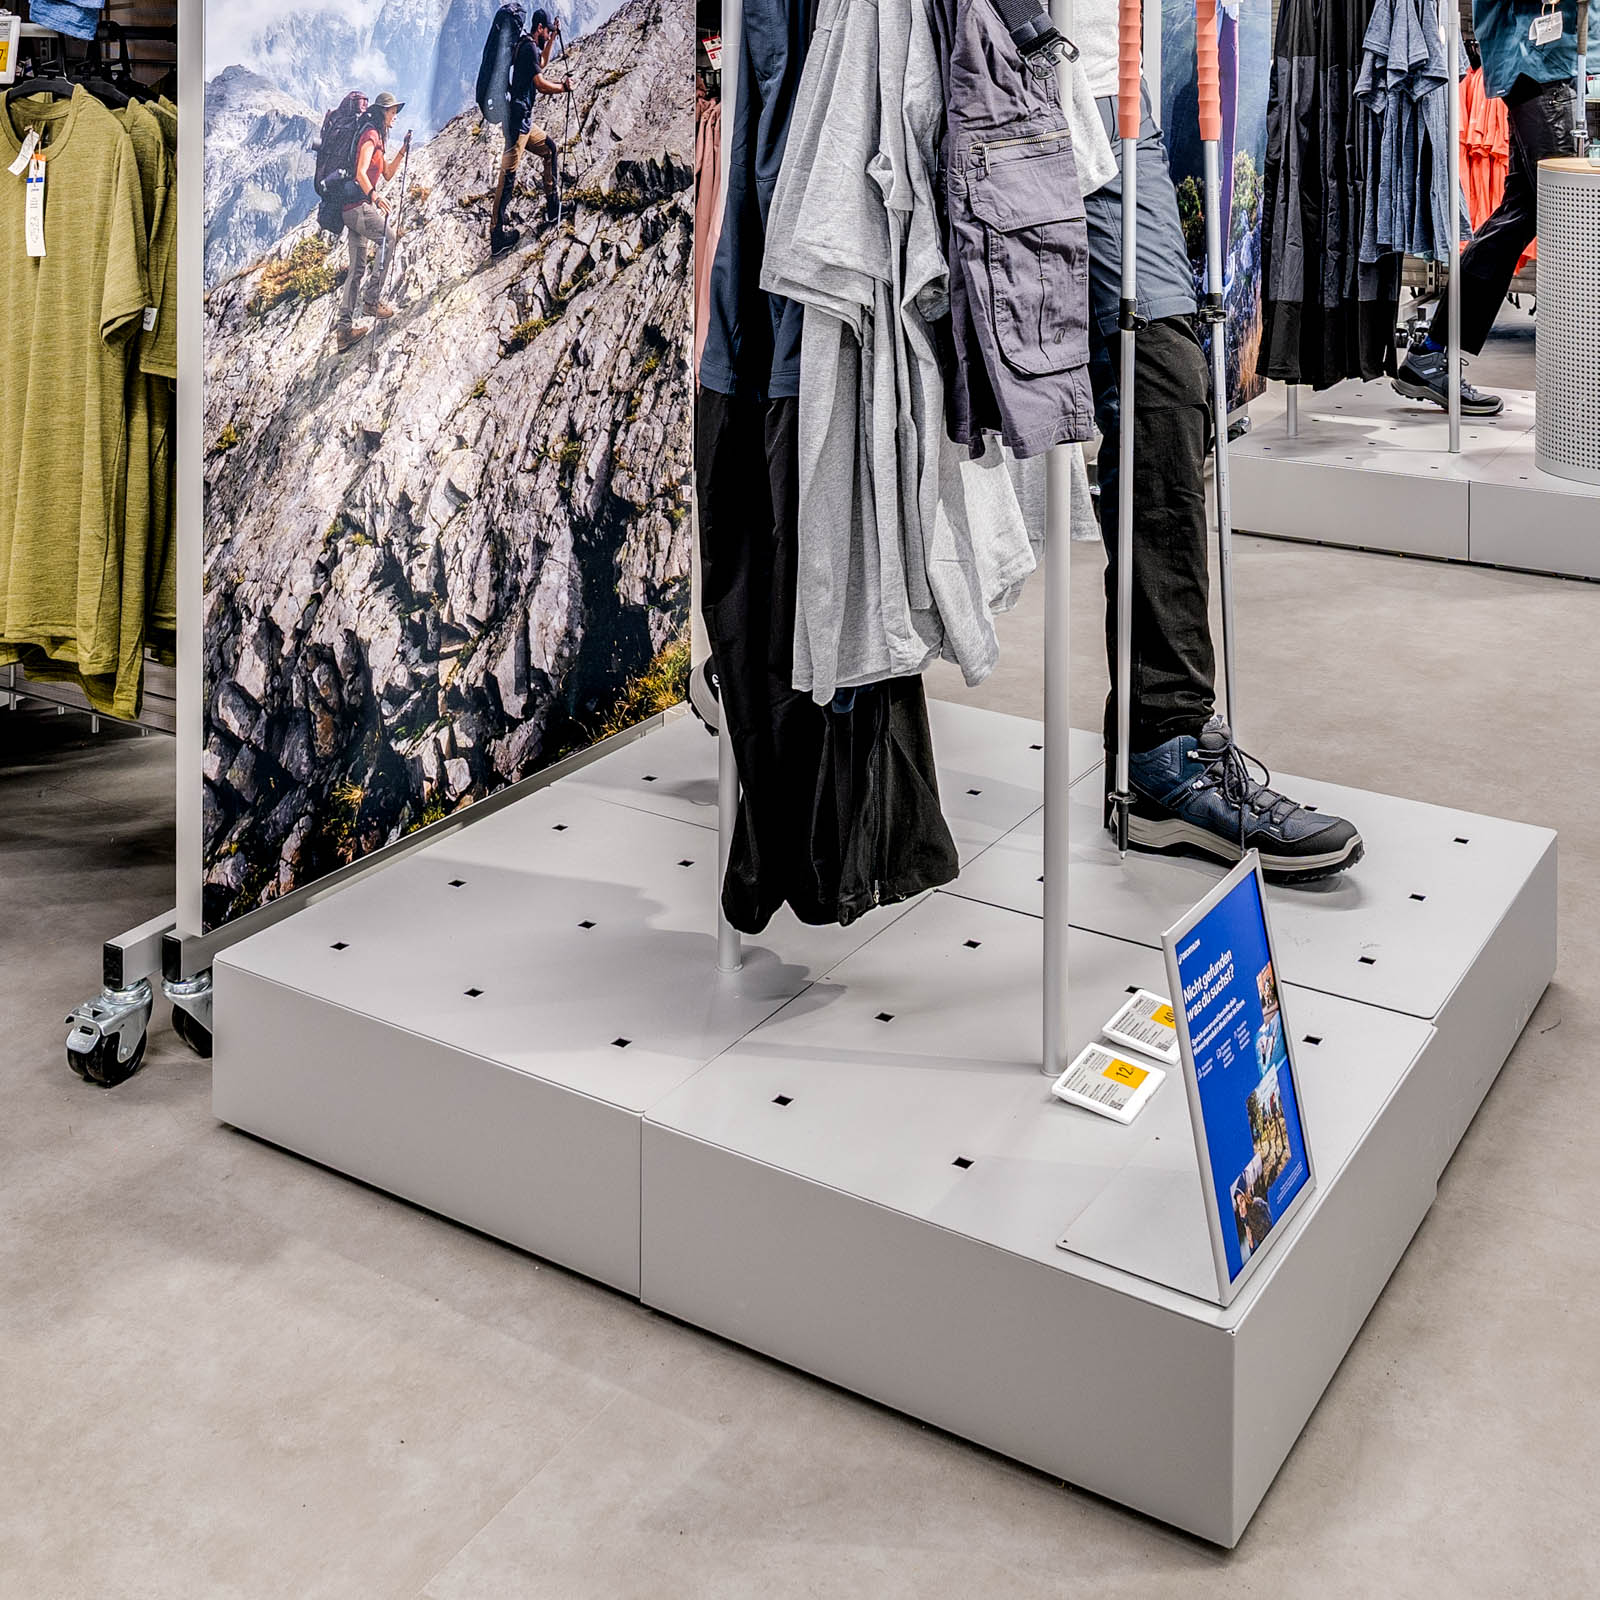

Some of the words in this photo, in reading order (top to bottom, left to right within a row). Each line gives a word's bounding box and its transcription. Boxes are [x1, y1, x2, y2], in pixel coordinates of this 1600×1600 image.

[1183, 976, 1203, 1005] Nicht
[1202, 950, 1233, 990] gefunden
[1187, 1003, 1202, 1023] was
[1201, 992, 1211, 1008] du
[1210, 964, 1234, 999] suchst?
